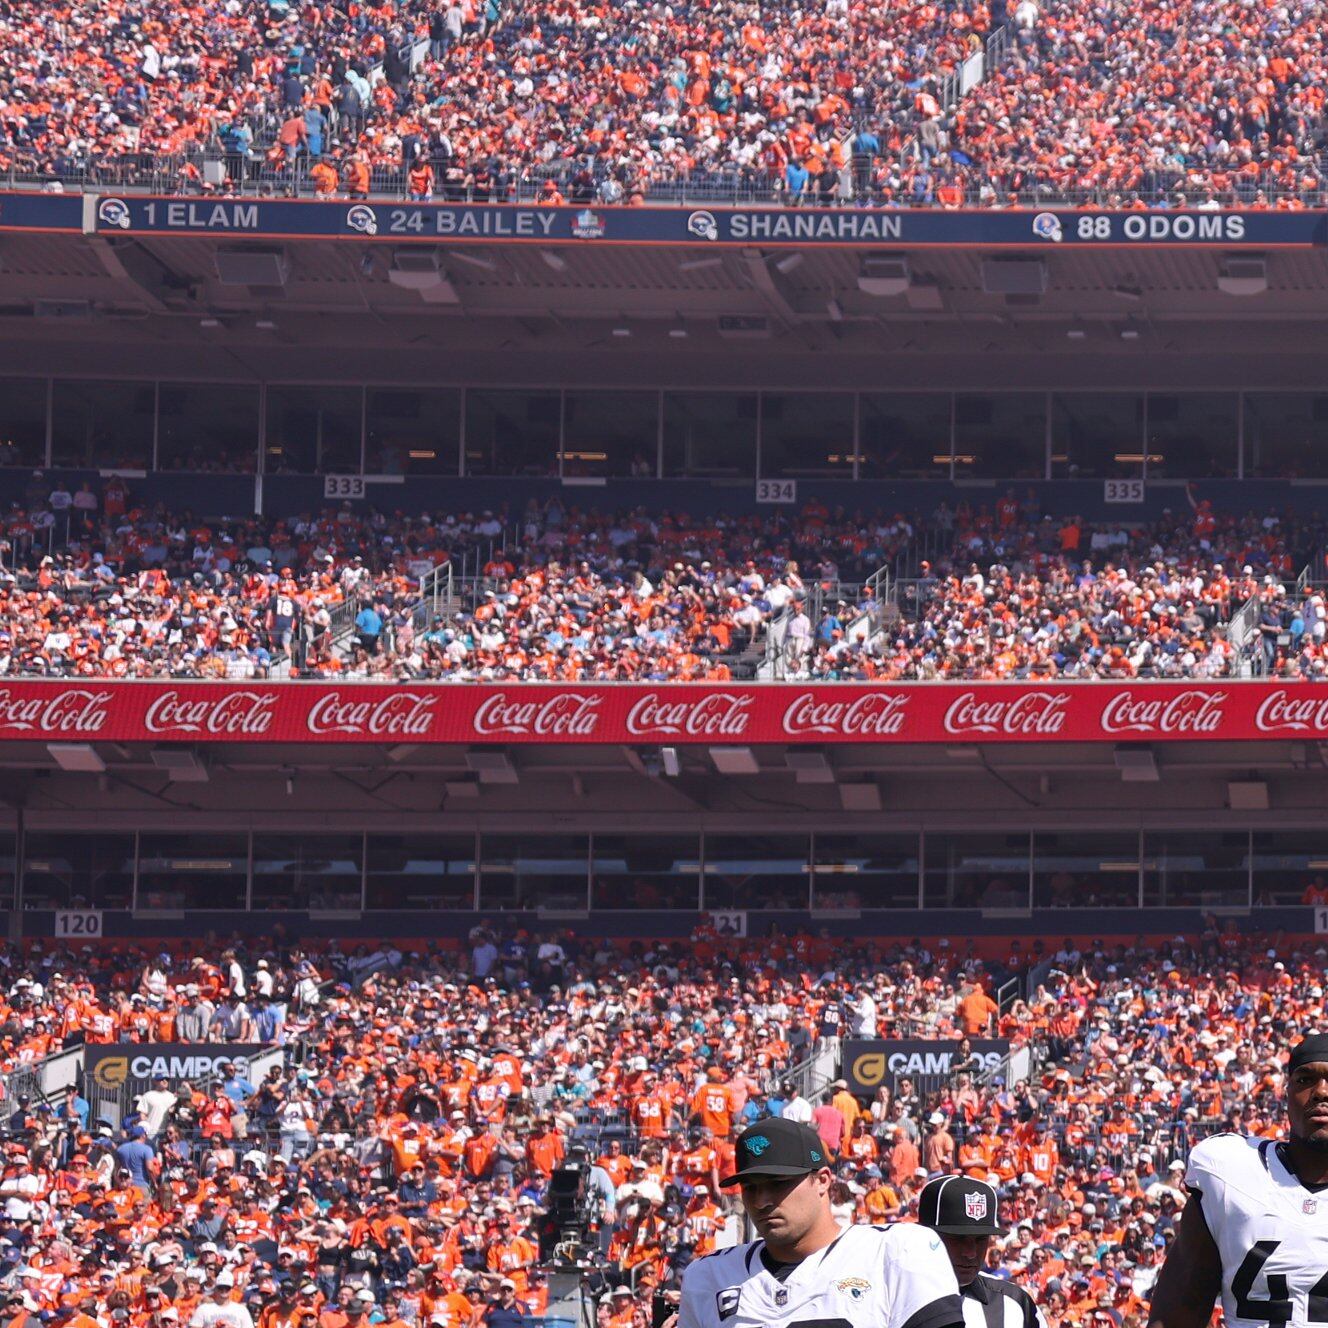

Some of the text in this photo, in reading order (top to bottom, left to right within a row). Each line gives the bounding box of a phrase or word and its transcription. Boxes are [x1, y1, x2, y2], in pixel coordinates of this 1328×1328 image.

[143, 203, 258, 228] 1 ELAM
[390, 210, 424, 232] 24
[436, 209, 557, 235] BAILEY
[730, 213, 901, 239] SHANAHAN
[1077, 215, 1246, 239] 88 ODOMS
[327, 477, 363, 495] 333
[759, 482, 793, 500] 334
[1108, 482, 1141, 499] 335
[60, 914, 98, 934] 120
[887, 1052, 1003, 1075] CAMOS
[1033, 1153, 1049, 1171] 10
[967, 1203, 987, 1218] NFL
